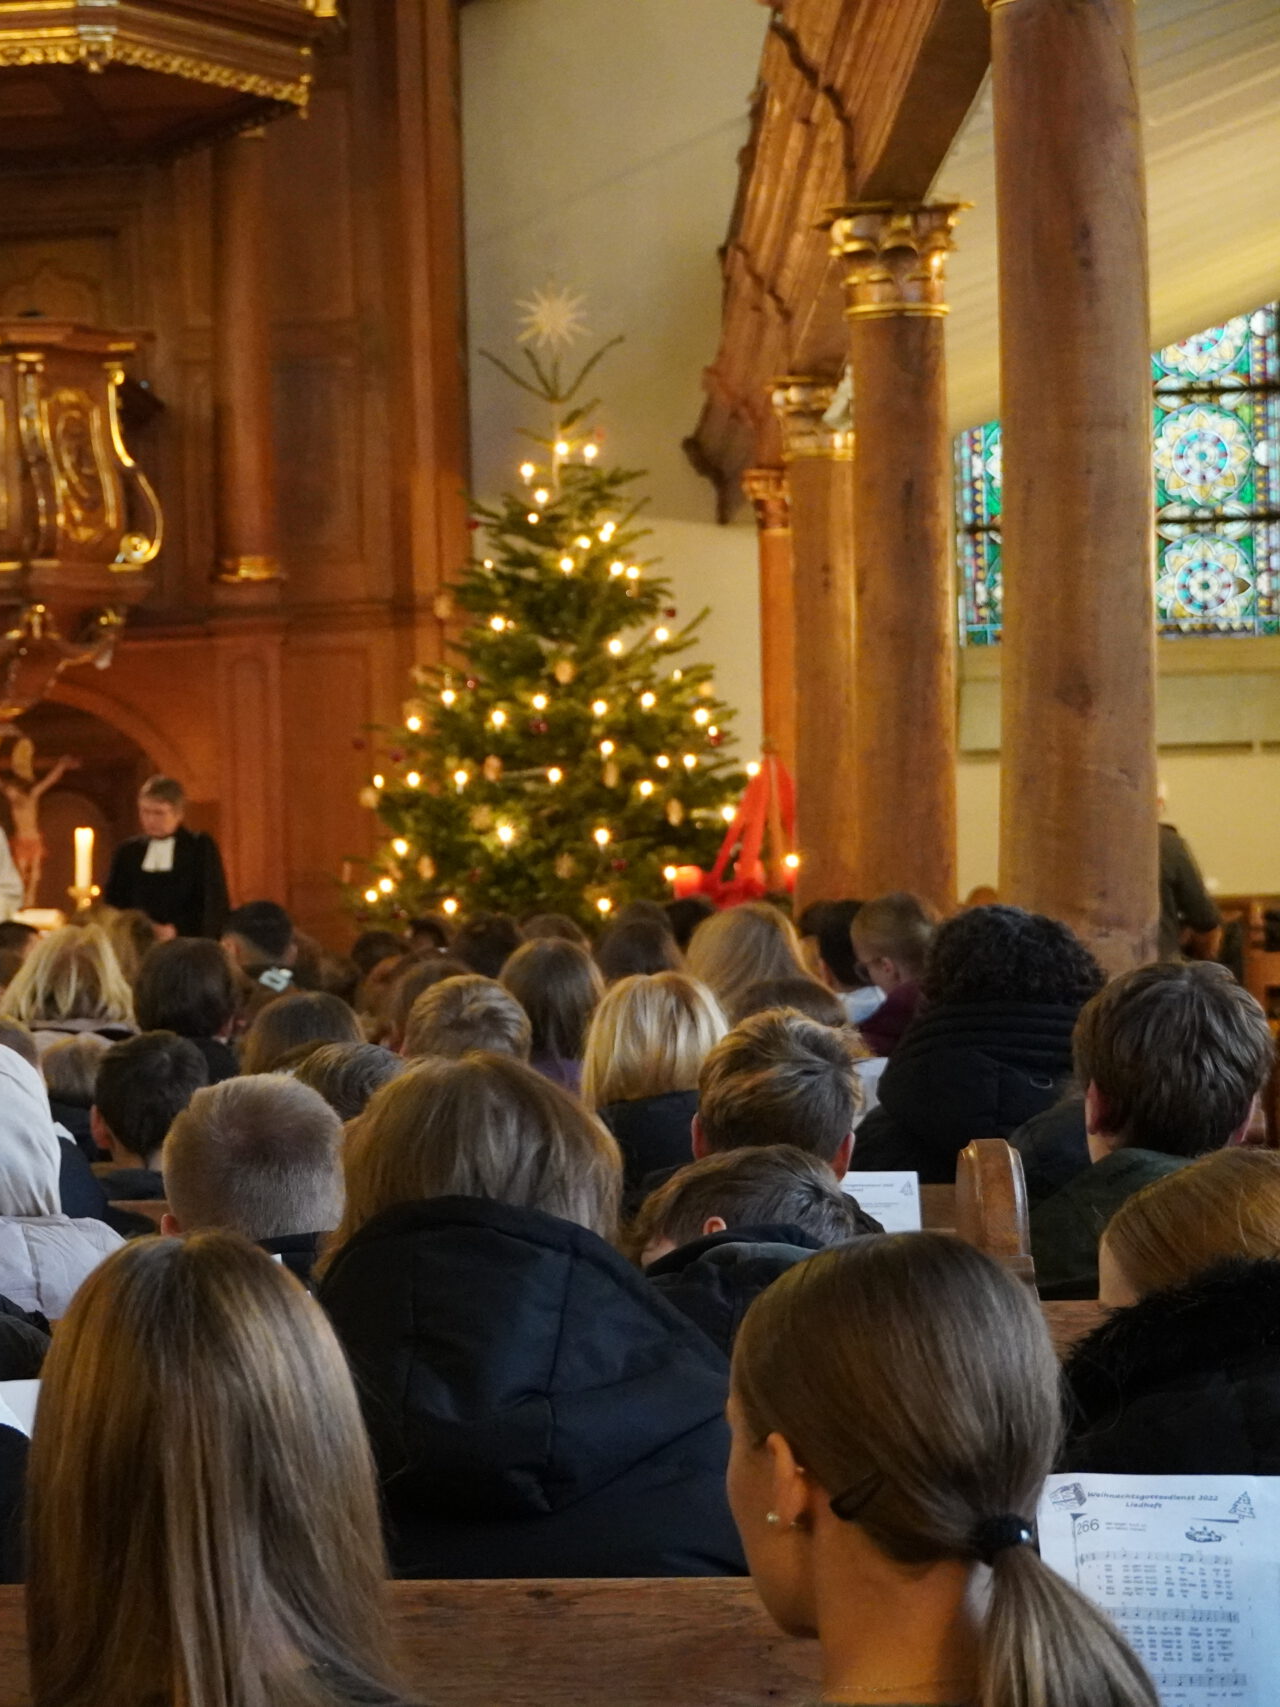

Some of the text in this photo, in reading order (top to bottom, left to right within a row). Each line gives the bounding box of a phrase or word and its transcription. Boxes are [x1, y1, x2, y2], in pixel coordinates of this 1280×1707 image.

[1087, 1490, 1195, 1501] Weihnachtsgottesdienst
[1125, 1502, 1162, 1510] Liedheft
[1077, 1519, 1100, 1536] 266
